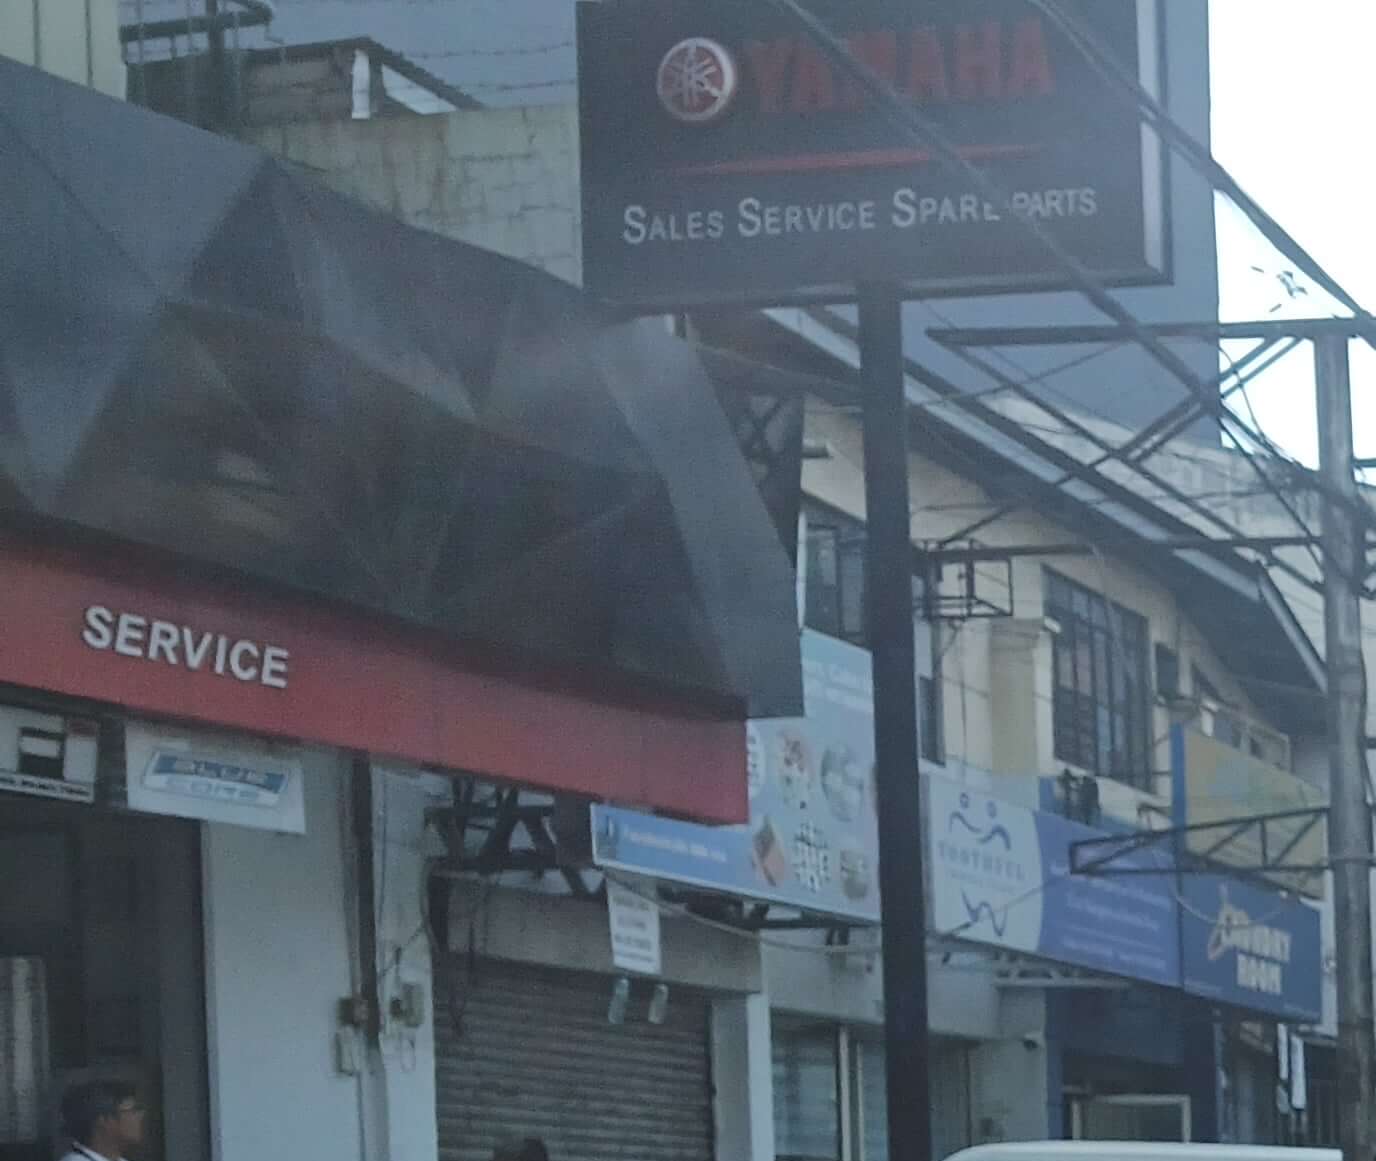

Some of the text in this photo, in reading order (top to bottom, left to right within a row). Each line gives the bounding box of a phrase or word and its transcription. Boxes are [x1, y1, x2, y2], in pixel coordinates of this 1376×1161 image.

[623, 204, 724, 245] SALES
[737, 196, 876, 238] SERVICE
[82, 605, 290, 689] SERVICE
